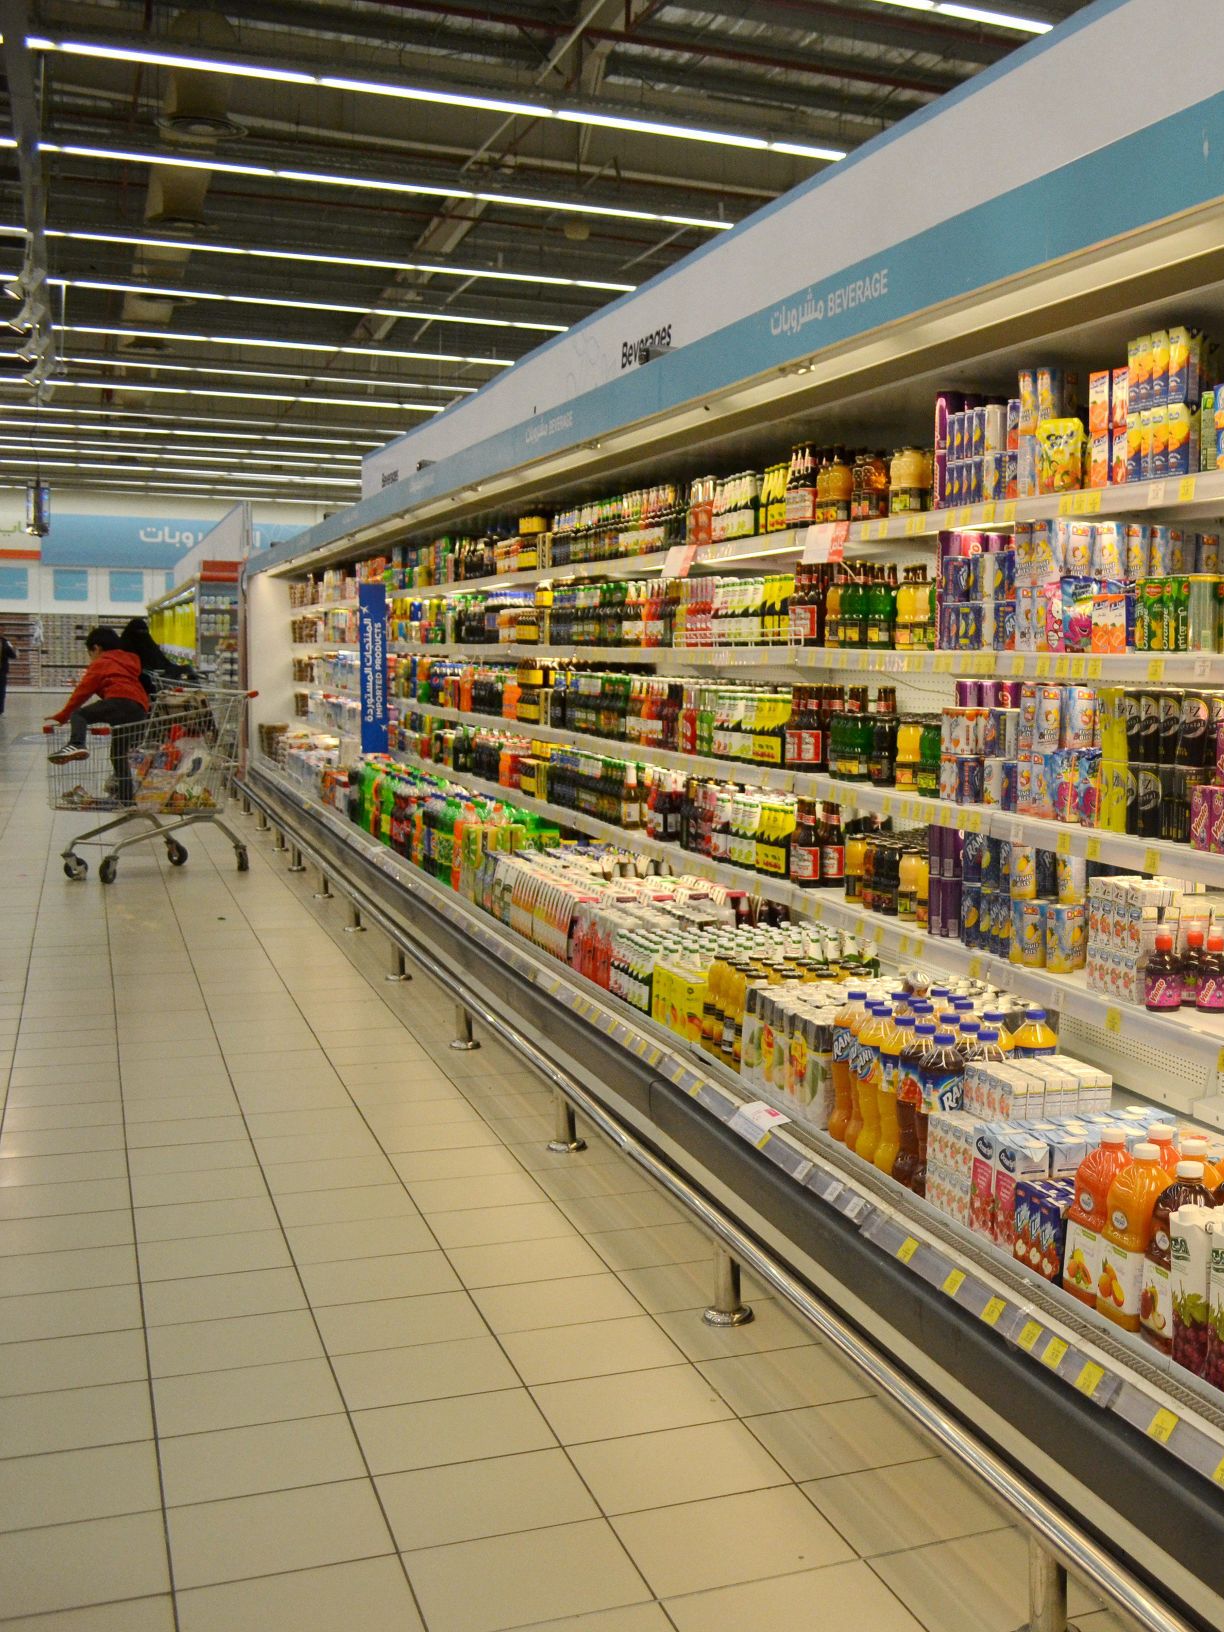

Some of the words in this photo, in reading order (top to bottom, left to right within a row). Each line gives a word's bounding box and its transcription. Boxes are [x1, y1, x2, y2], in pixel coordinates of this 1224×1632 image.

[771, 288, 824, 336] مشروبات
[828, 269, 888, 317] BEVERAGE
[374, 622, 382, 671] PRODUCTS
[375, 672, 383, 718] IMPORTED
[1192, 803, 1209, 837] Vimto
[1150, 979, 1165, 1001] Vimto
[1200, 979, 1216, 1003] Vimto
[833, 1031, 850, 1059] RAN
